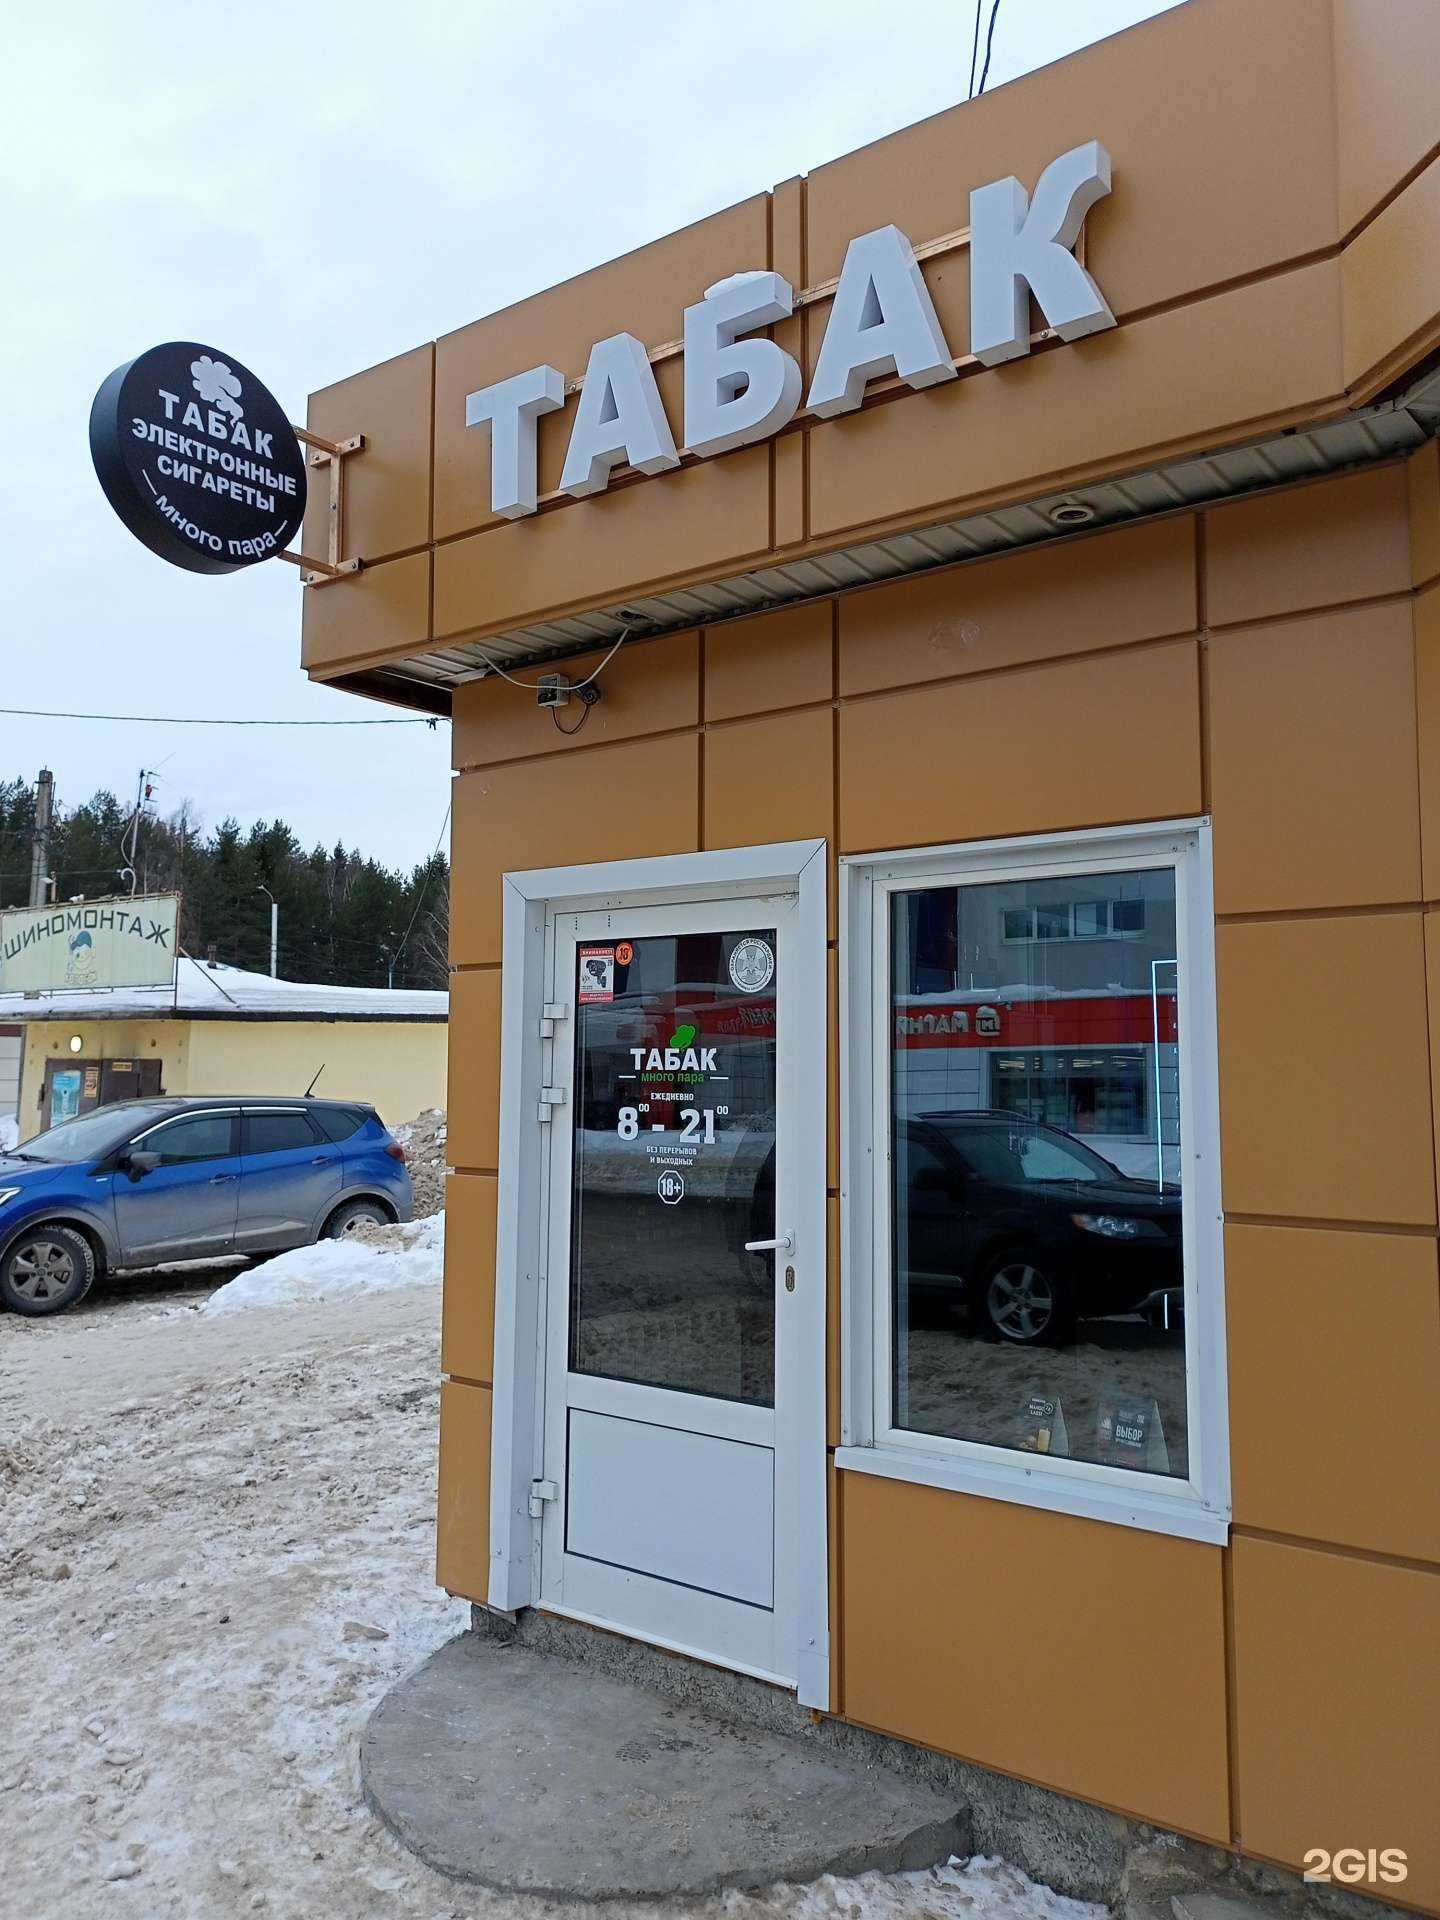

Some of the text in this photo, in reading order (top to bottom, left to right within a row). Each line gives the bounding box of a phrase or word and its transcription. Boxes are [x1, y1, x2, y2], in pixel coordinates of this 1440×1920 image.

[466, 140, 1117, 520] ТАБАК
[158, 389, 273, 460] ТАБАК
[131, 418, 297, 496] ЭЛЕКТРОННЫЕ
[157, 455, 275, 513] СИГАРЕТЫ
[228, 531, 278, 558] пара
[4, 910, 170, 960] ШИНОМОНТАЖ
[630, 1048, 717, 1071] ТАБАК
[641, 1073, 705, 1084] много пара
[650, 1092, 694, 1101] ЕЖЕДНЕВНО
[646, 1145, 697, 1155] БЕЗ ПЕРЕРЫВОВ
[656, 1157, 693, 1166] ВЫХОДНЫХ
[660, 1179, 681, 1196] 18+
[1115, 1425, 1143, 1441] ВЫБОР
